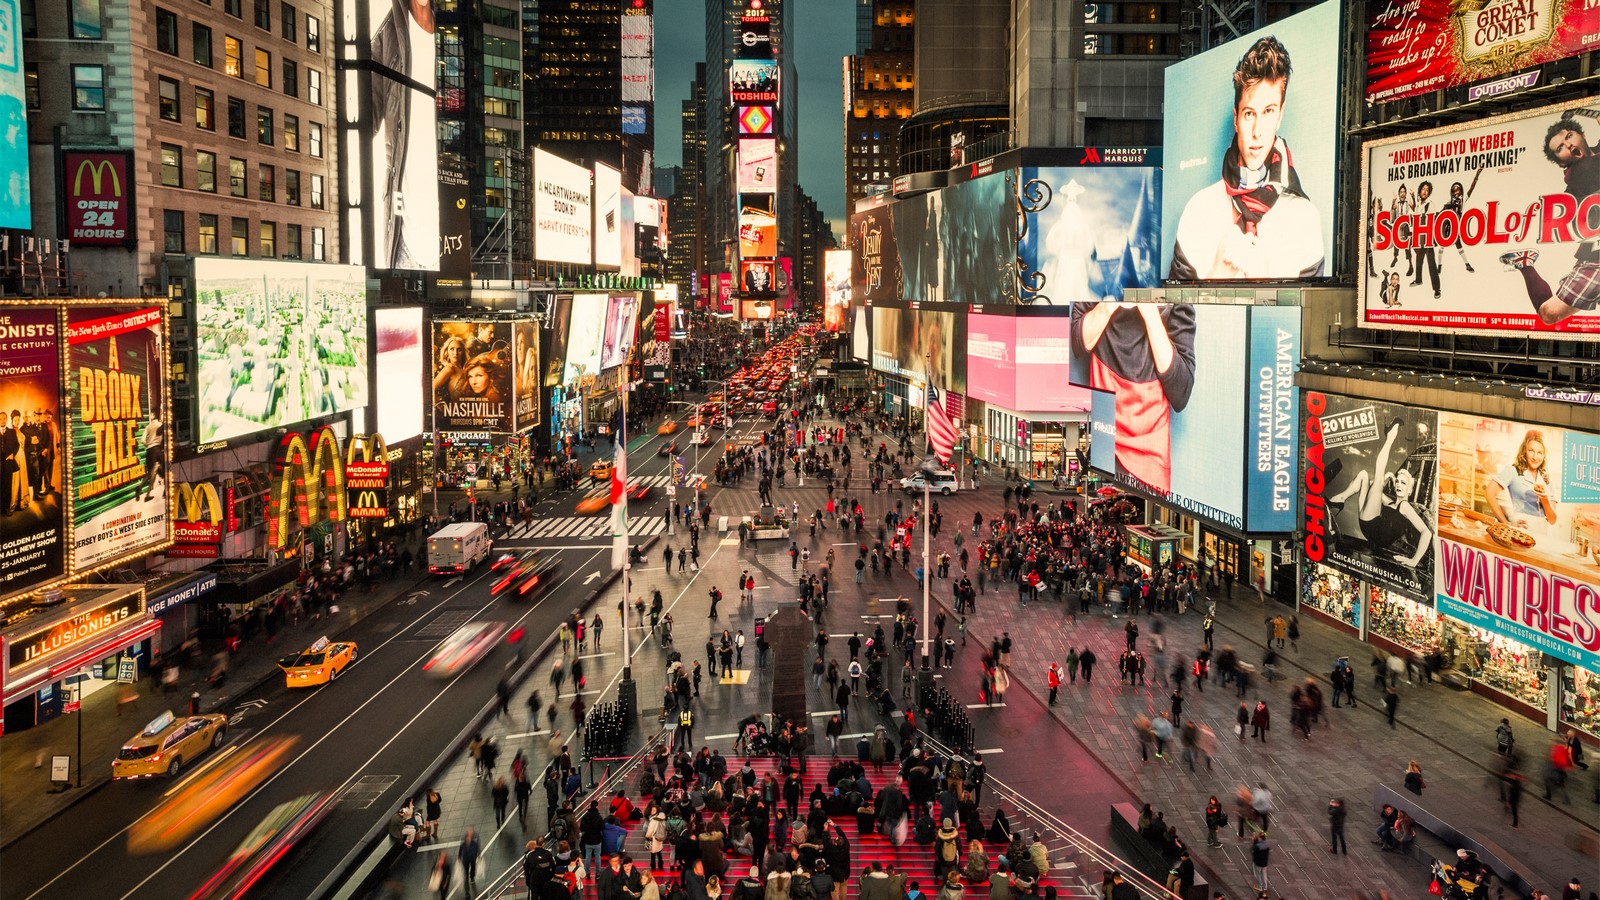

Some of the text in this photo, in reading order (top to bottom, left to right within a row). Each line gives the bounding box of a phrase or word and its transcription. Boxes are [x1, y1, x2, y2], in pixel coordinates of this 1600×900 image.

[1476, 0, 1535, 28] GREAT
[1415, 21, 1426, 35] to
[1475, 11, 1539, 46] COMET
[1494, 44, 1516, 57] 1812
[733, 92, 777, 100] TOSHIBA
[1375, 88, 1394, 99] IMPERIAL
[1395, 83, 1412, 94] THEATRE
[1475, 74, 1532, 97] OUTFRONT
[1434, 139, 1466, 160] LLOYD
[1469, 130, 1515, 152] WEBBER
[1388, 165, 1405, 182] HAS
[1408, 157, 1461, 178] BROADWAY
[538, 179, 589, 206] A HEARTWARMING
[77, 200, 119, 209] OPEN
[554, 199, 577, 216] BOOK BY
[82, 211, 115, 227] 24
[538, 219, 562, 233] HARVEY
[1375, 201, 1510, 251] SCHOOL
[1538, 193, 1600, 245] RO
[73, 229, 125, 239] HOURS
[0, 324, 55, 339] ONISTS
[79, 326, 92, 336] New
[92, 323, 106, 335] York
[106, 321, 123, 331] Times
[147, 310, 160, 322] PICK
[1467, 316, 1487, 324] THEATRE
[1508, 318, 1536, 326] BROADWAY
[108, 335, 120, 370] A
[80, 367, 143, 422] BRONX
[443, 402, 505, 417] NASHVILLE
[1257, 366, 1274, 472] OUTFITTERS
[1272, 328, 1293, 512] AMERICAN EAGLE
[1322, 410, 1374, 434] 20 YEARS
[92, 419, 139, 476] TALE
[447, 432, 491, 440] LUGGAGE
[1304, 391, 1327, 562] CHICAGO
[1113, 472, 1242, 530] AMERICAN EAGLE OUTFITTERS
[106, 514, 136, 529] COMBINATION
[136, 512, 142, 520] OF
[174, 527, 219, 536] cDonald's
[2, 528, 56, 550] GOLDEN AGE OF
[74, 535, 96, 549] JERSEY
[97, 530, 113, 541] BOYS
[119, 522, 134, 534] WEST
[135, 519, 146, 529] SIDE
[5, 548, 19, 558] ALL
[19, 542, 36, 553] NEW
[36, 536, 57, 548] SHOW
[1, 551, 41, 569] 25-JANUARY
[13, 563, 47, 578] Palace Theatre
[1332, 551, 1422, 590] CHICAGOTHEMUSICAL.COM
[167, 587, 197, 607] MONEY
[200, 577, 217, 592] ATM
[1440, 539, 1600, 653] WAITRES
[73, 612, 91, 626] THE
[24, 606, 129, 662] ILLUSIONISTS
